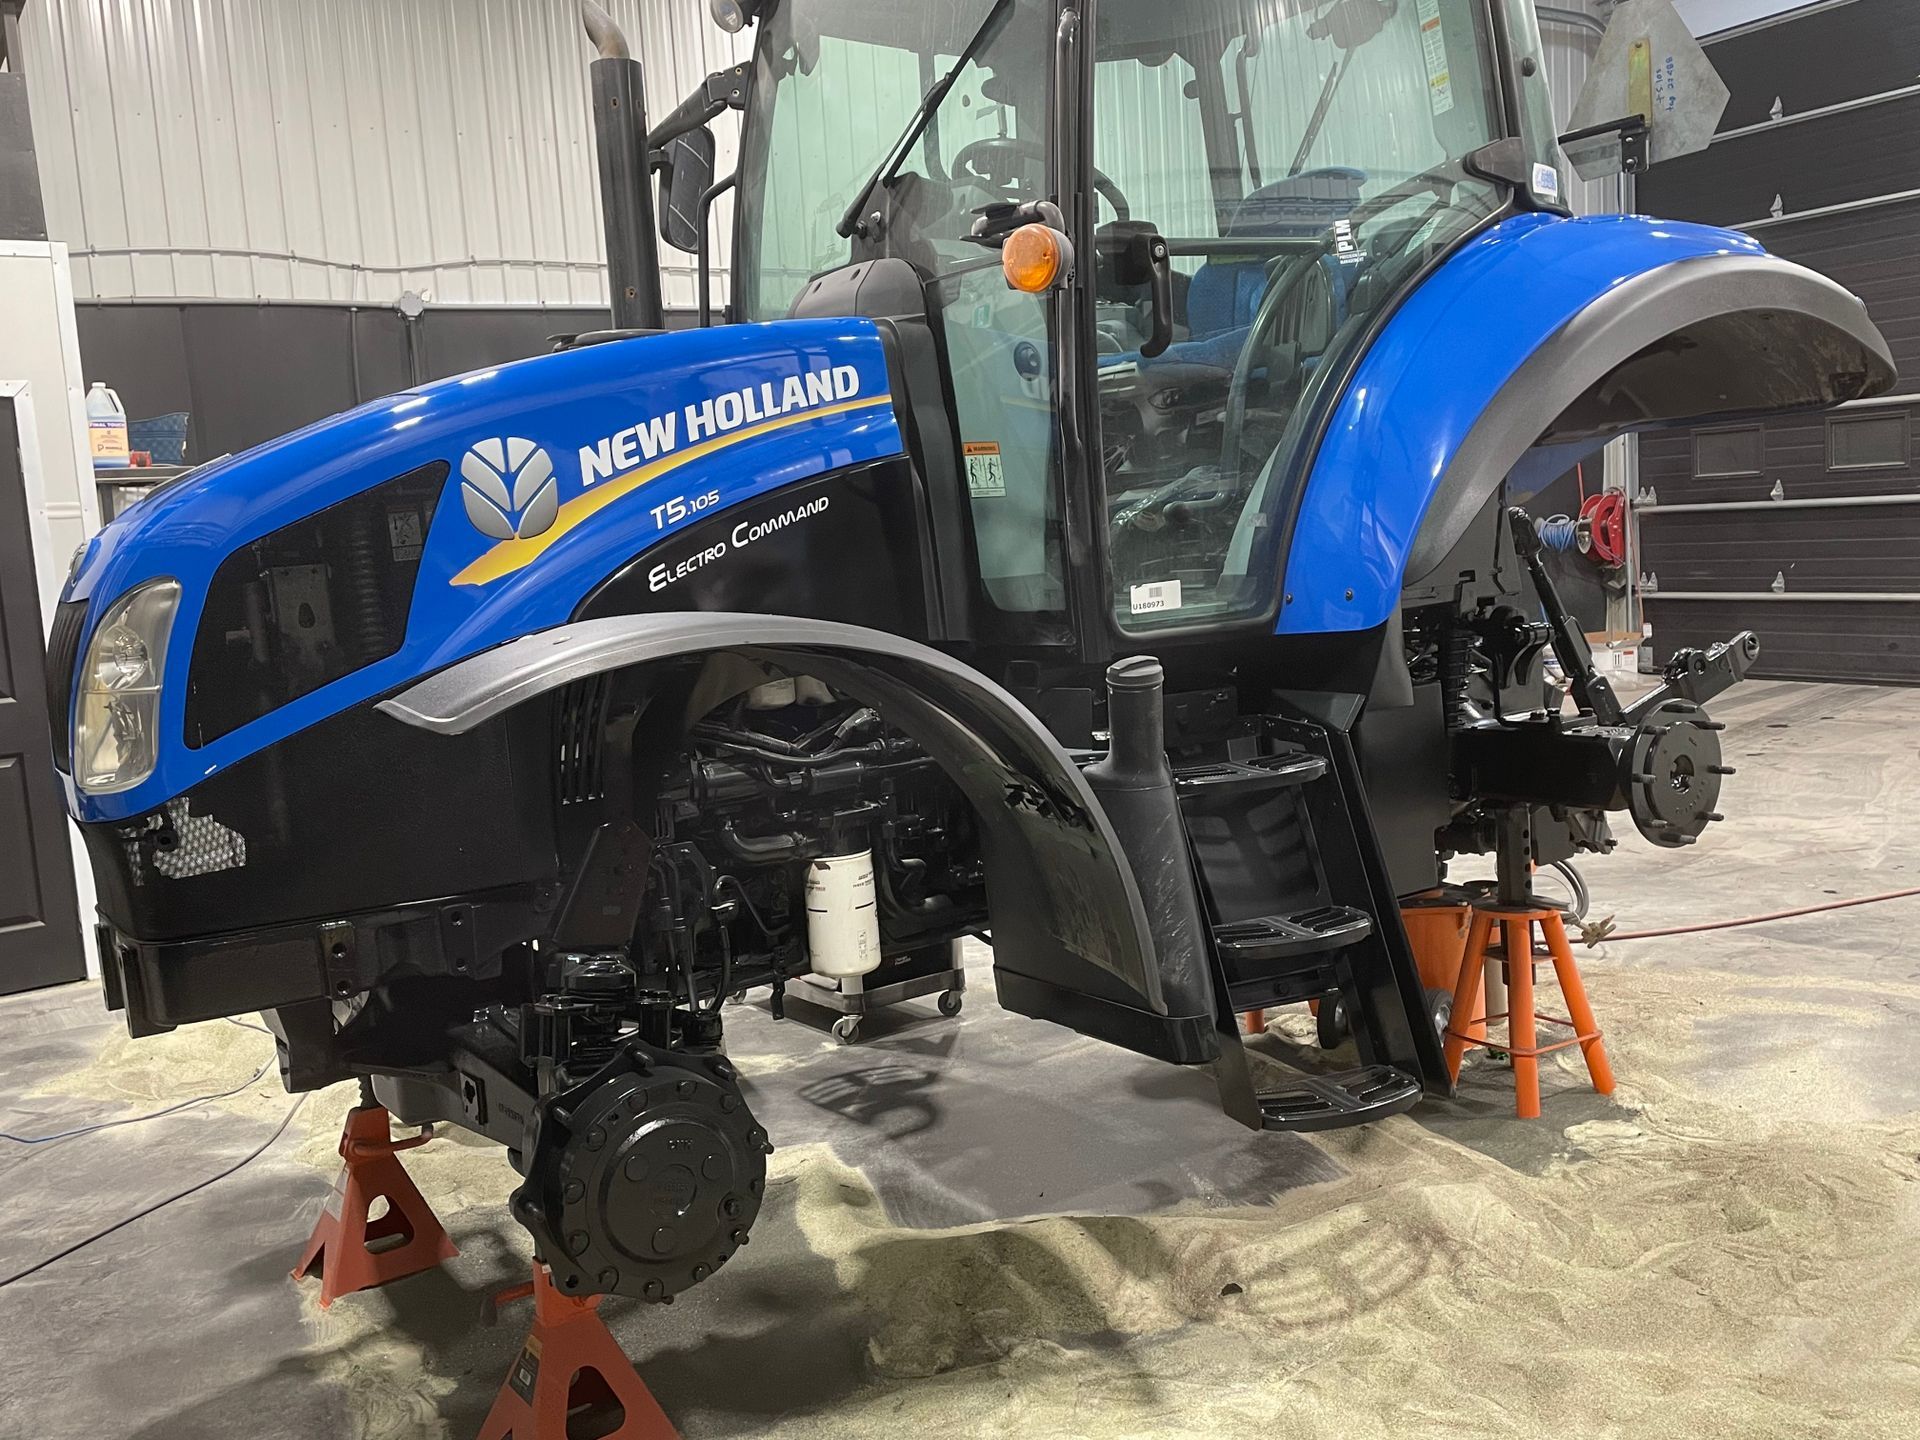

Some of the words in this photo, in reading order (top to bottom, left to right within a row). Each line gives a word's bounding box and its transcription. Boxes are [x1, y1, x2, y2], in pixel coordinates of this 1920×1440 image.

[1335, 220, 1353, 252] PLM
[578, 412, 677, 487] NEW
[684, 365, 860, 442] HOLLAND
[650, 490, 720, 530] T5.105
[649, 541, 726, 593] ELECTRO
[731, 496, 829, 548] COMMAND
